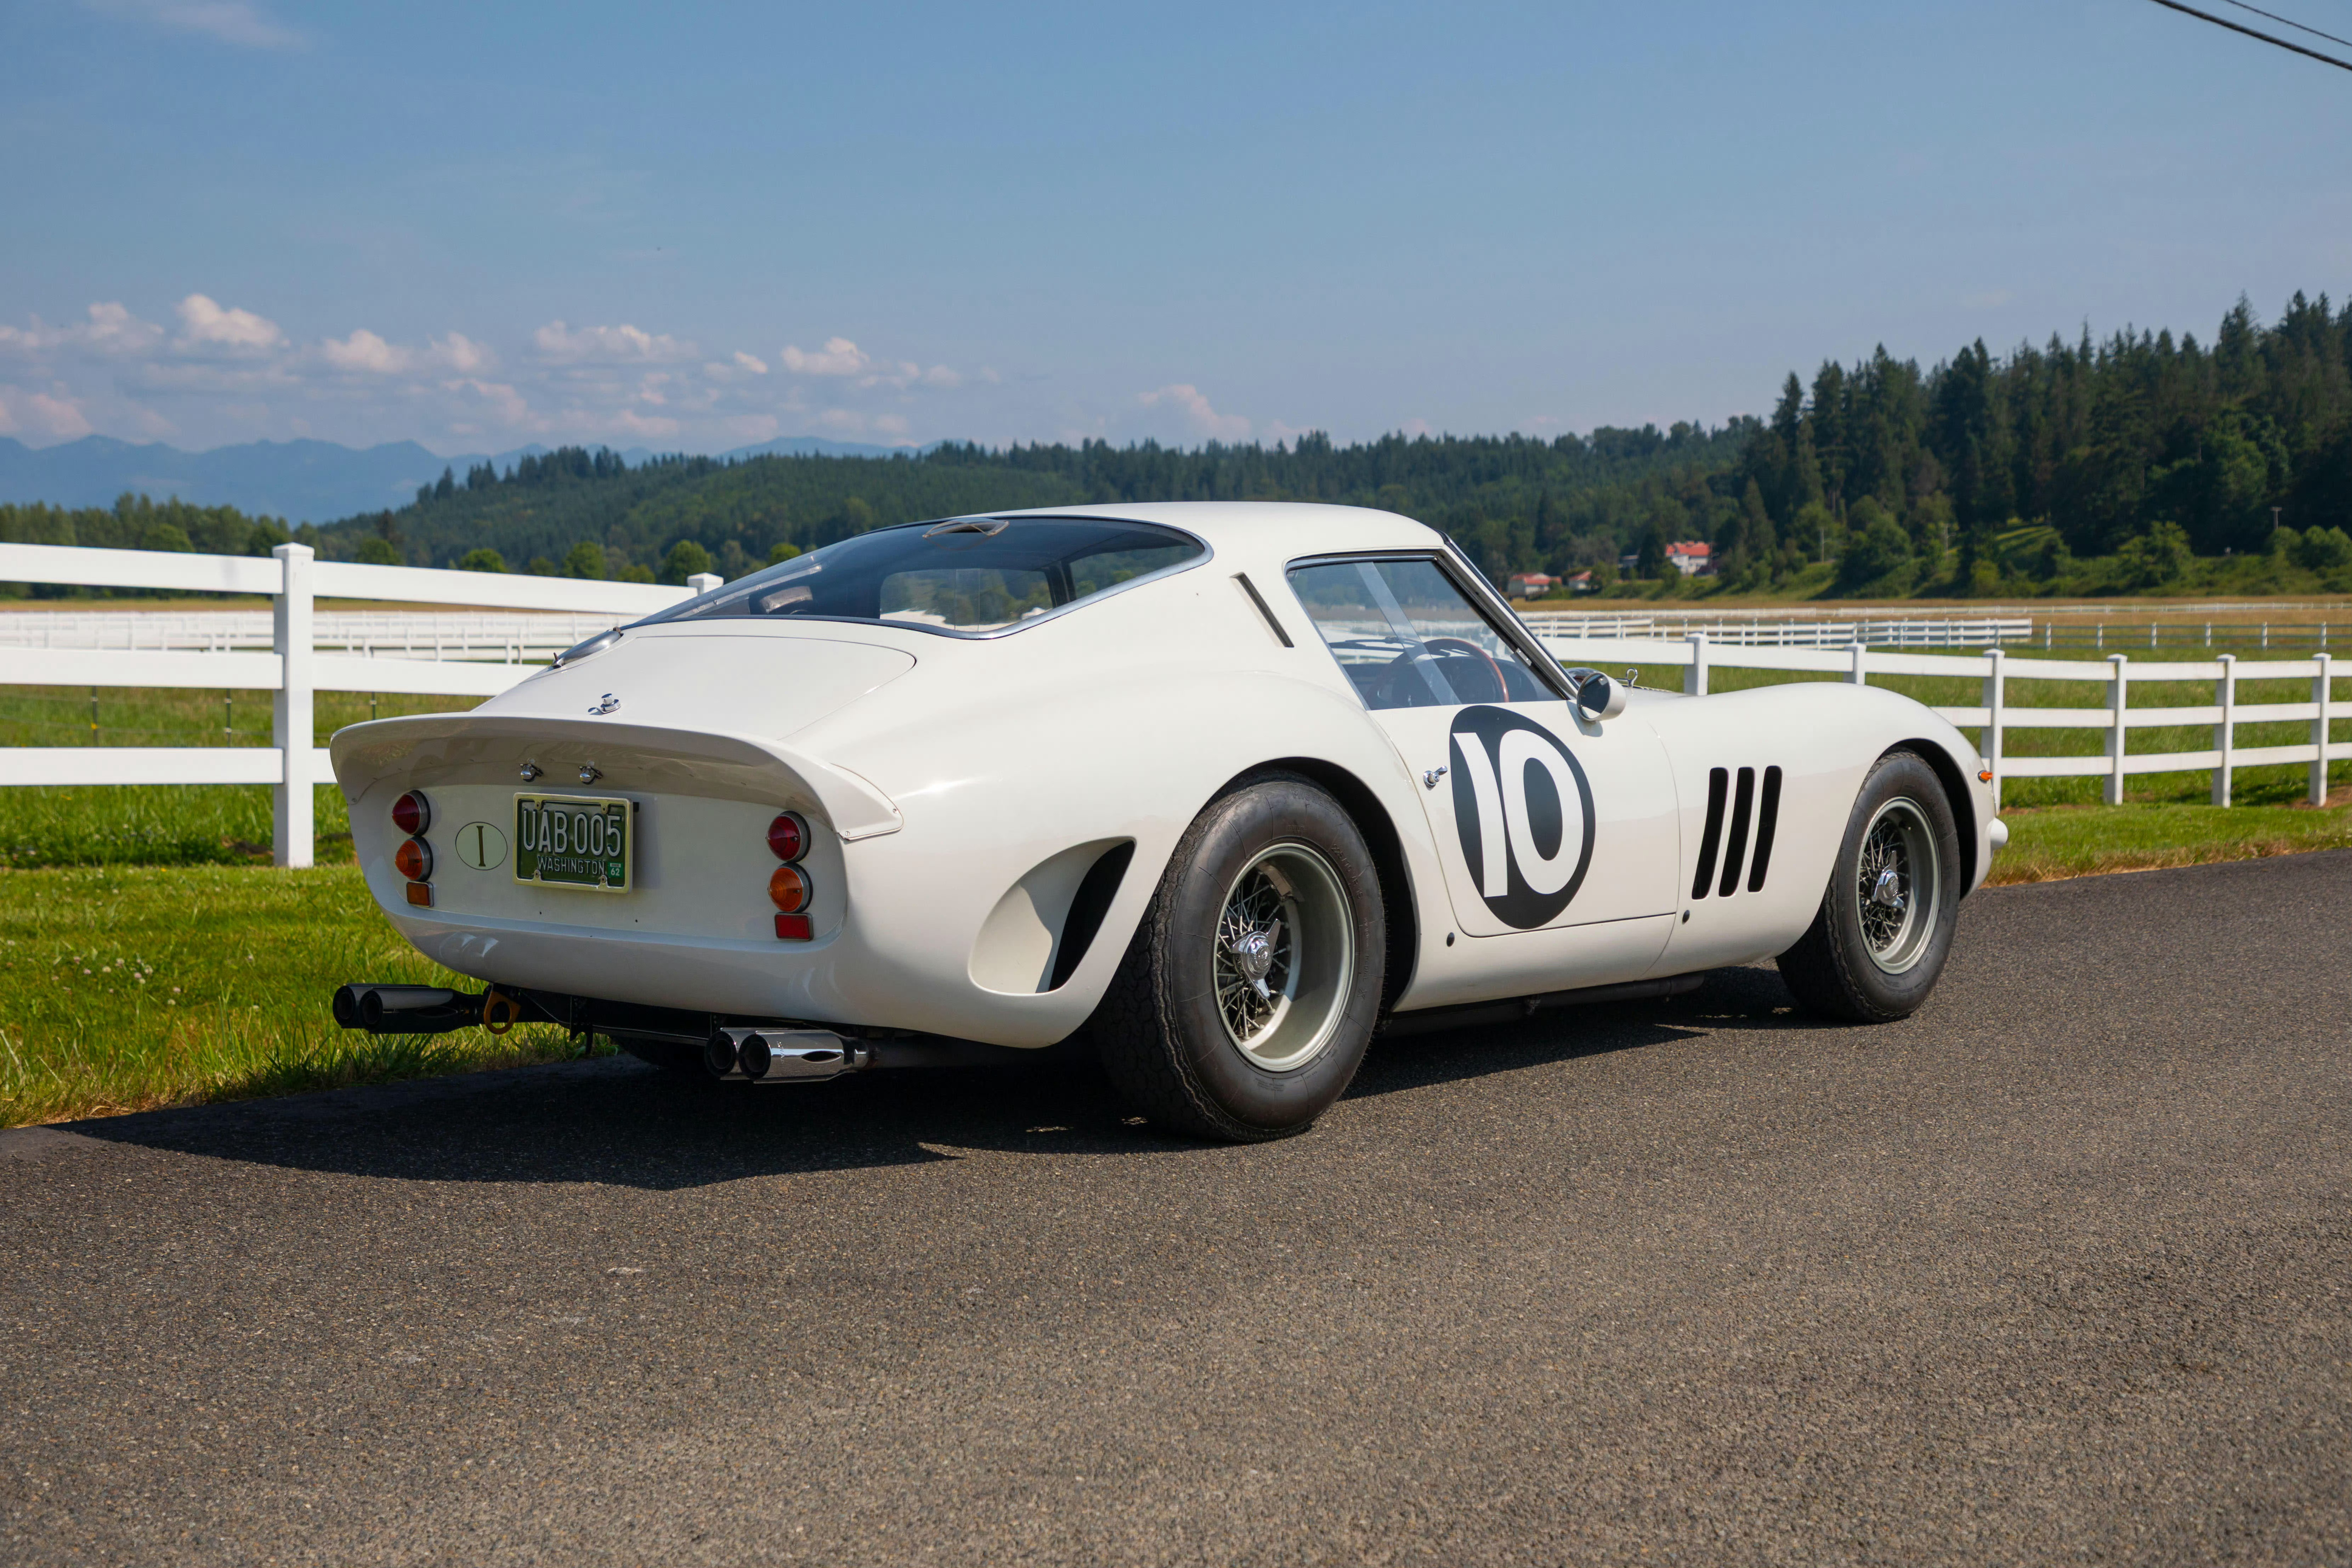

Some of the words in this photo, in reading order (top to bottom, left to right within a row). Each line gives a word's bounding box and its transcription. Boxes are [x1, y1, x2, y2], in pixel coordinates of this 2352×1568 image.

[523, 810, 567, 853] UAB
[574, 813, 621, 857] 005
[1452, 729, 1584, 897] 10
[477, 825, 486, 867] I
[538, 857, 606, 875] WASHINGTON
[611, 868, 620, 876] 62
